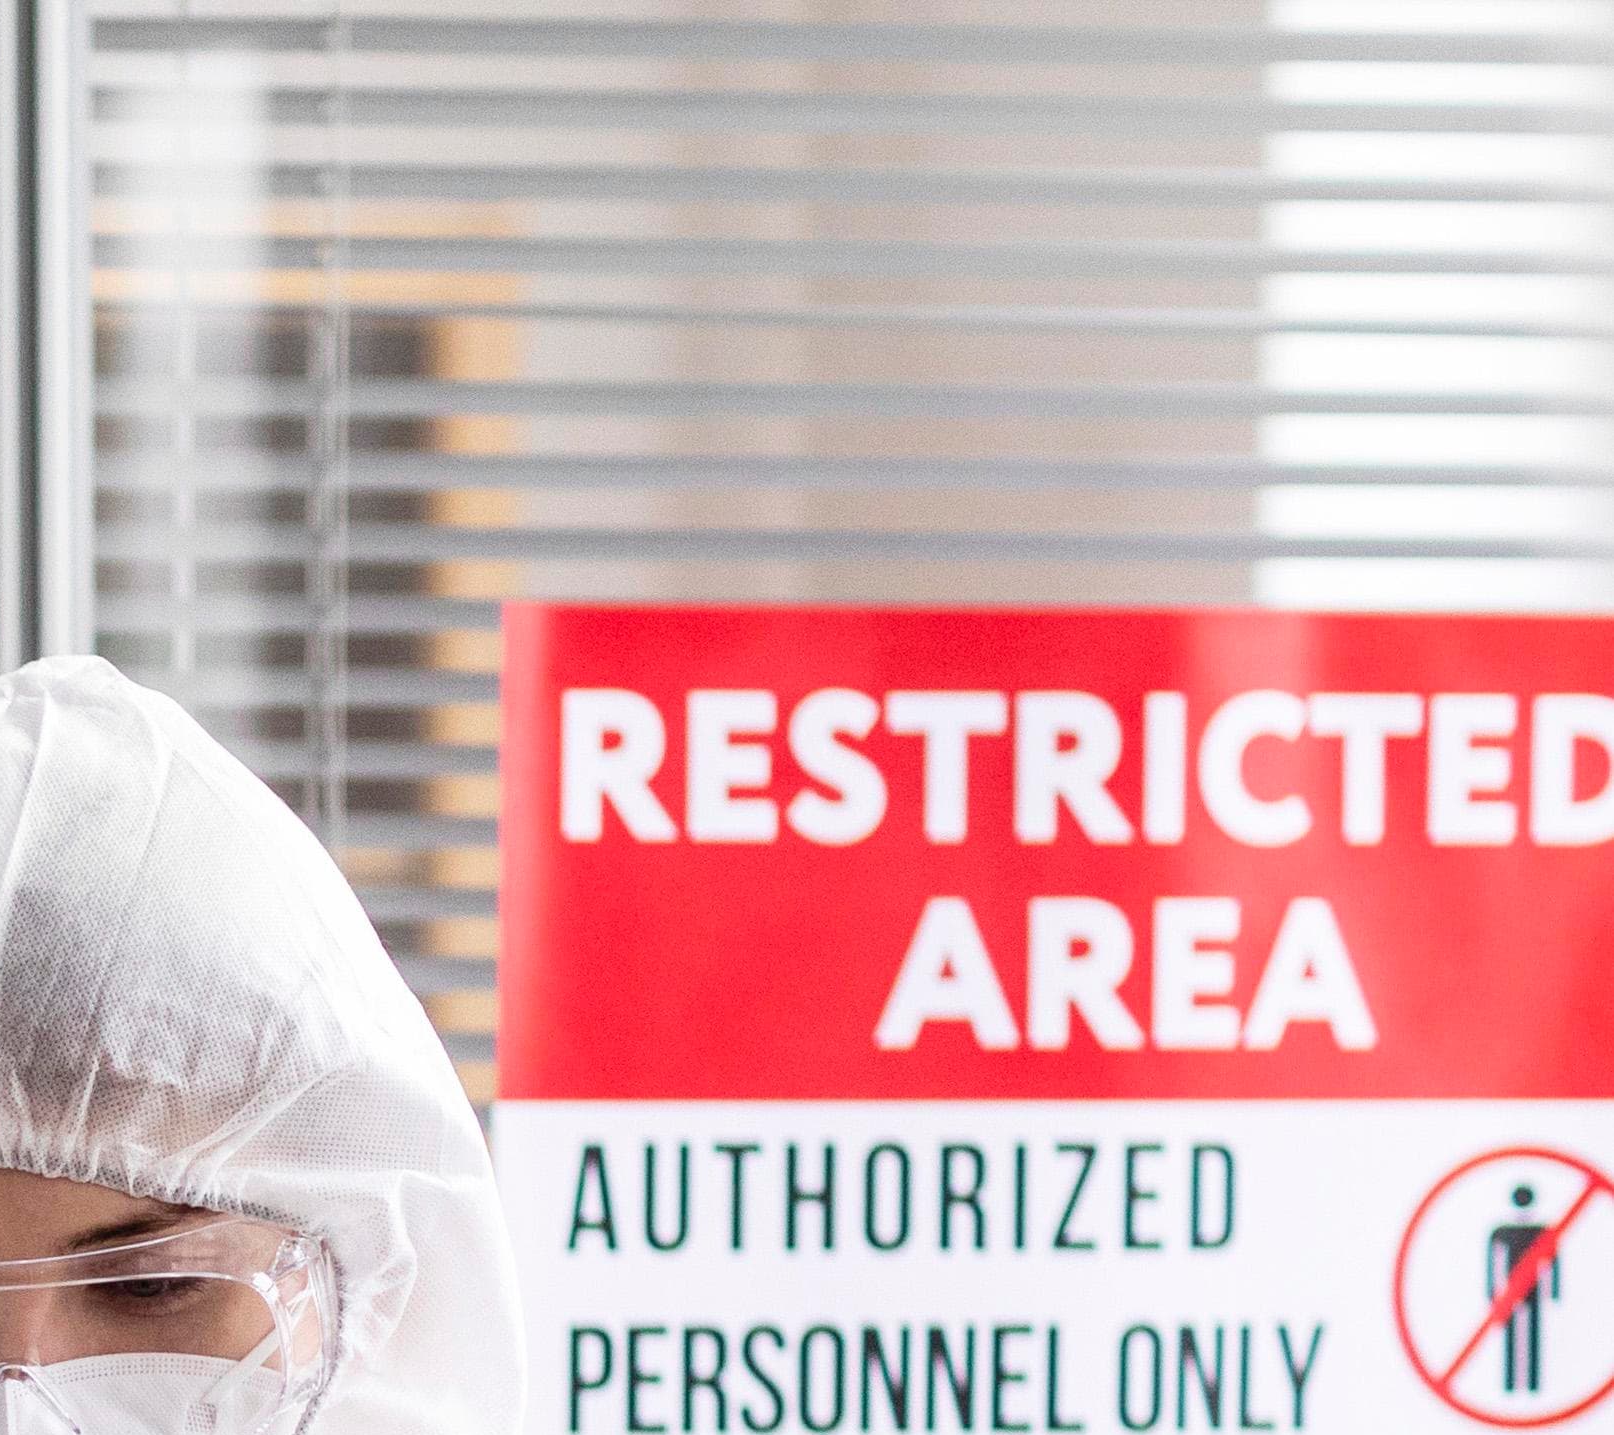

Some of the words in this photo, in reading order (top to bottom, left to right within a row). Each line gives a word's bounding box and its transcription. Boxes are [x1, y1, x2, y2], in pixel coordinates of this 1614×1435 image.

[559, 687, 1614, 848] RESTRICTED
[874, 895, 1382, 1054] AREA
[566, 1141, 1237, 1255] AUTHORIZED
[567, 1323, 1086, 1435] PERSONNEL
[1116, 1323, 1326, 1435] ONLY
